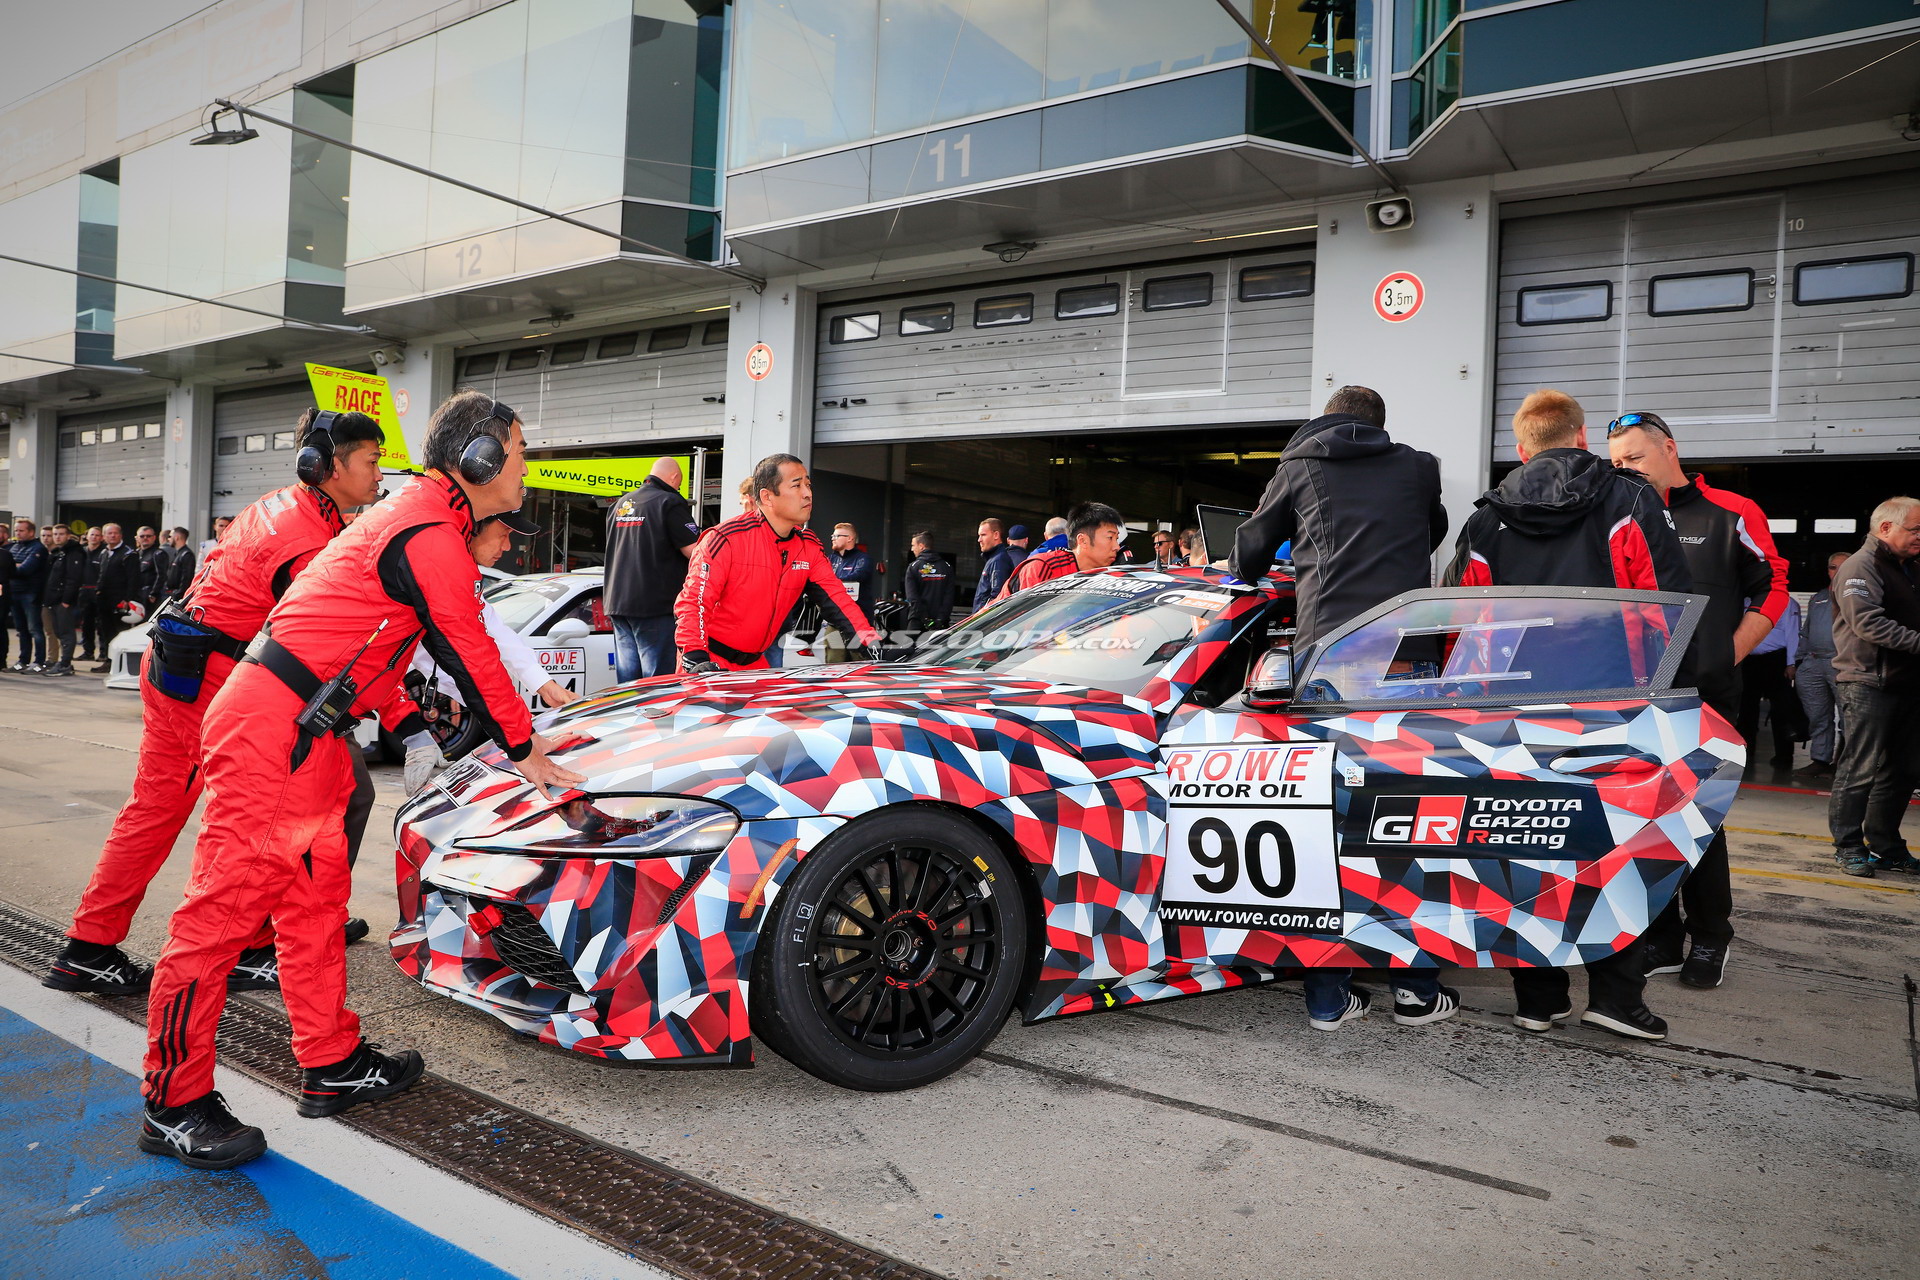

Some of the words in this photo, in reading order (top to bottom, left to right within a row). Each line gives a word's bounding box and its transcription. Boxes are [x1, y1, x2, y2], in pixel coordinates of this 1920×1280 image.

[929, 133, 971, 182] 11
[1787, 218, 1804, 231] 10
[455, 243, 482, 278] 12
[1384, 288, 1413, 307] 3.5m
[185, 310, 202, 336] 13
[335, 385, 382, 415] RACE
[540, 468, 643, 489] www.getspe
[541, 652, 577, 665] OWE
[1169, 748, 1314, 782] ROWE
[1169, 784, 1250, 798] MOTOR
[1260, 784, 1303, 798] OIL
[1472, 797, 1583, 812] TOYOTA
[1372, 815, 1459, 842] GR
[1469, 813, 1571, 829] GAZOO
[1466, 829, 1566, 850] Racing
[1188, 816, 1297, 899] 90
[1158, 907, 1341, 930] www.rowe.com.de
